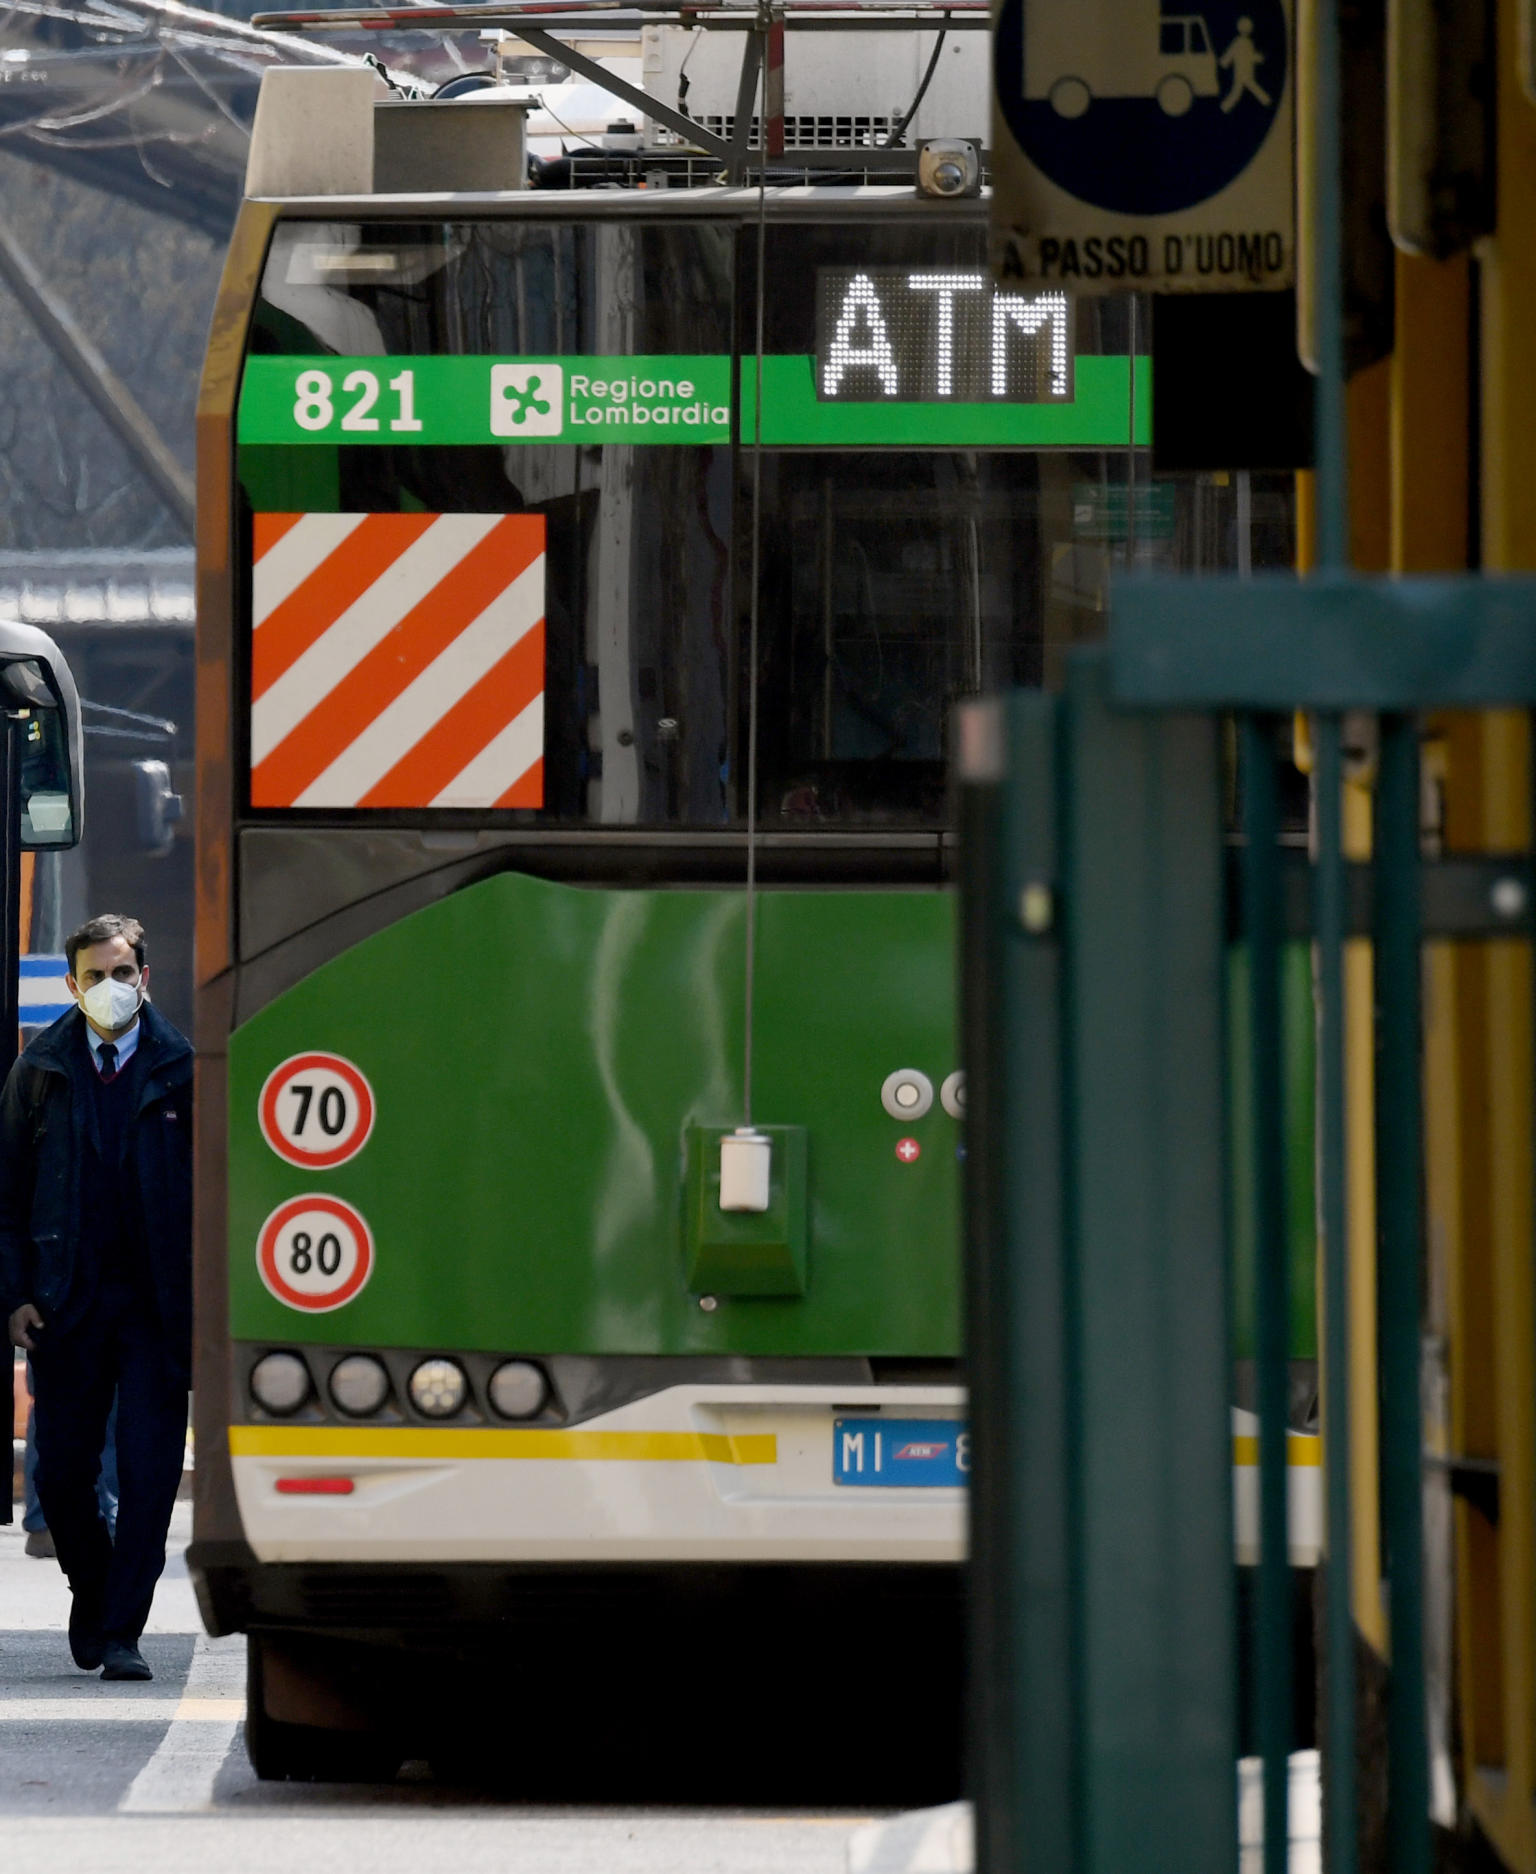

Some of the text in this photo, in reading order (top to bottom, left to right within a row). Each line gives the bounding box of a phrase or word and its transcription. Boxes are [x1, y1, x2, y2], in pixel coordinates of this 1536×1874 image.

[1040, 235, 1149, 277] PASSO
[1164, 231, 1283, 275] D'UOMO
[823, 274, 1066, 395] ATM
[293, 370, 423, 431] 821
[569, 375, 694, 403] Regione
[569, 402, 730, 425] Lombardia
[291, 1086, 346, 1135] 70
[291, 1232, 340, 1275] 80
[842, 1432, 881, 1472] MI
